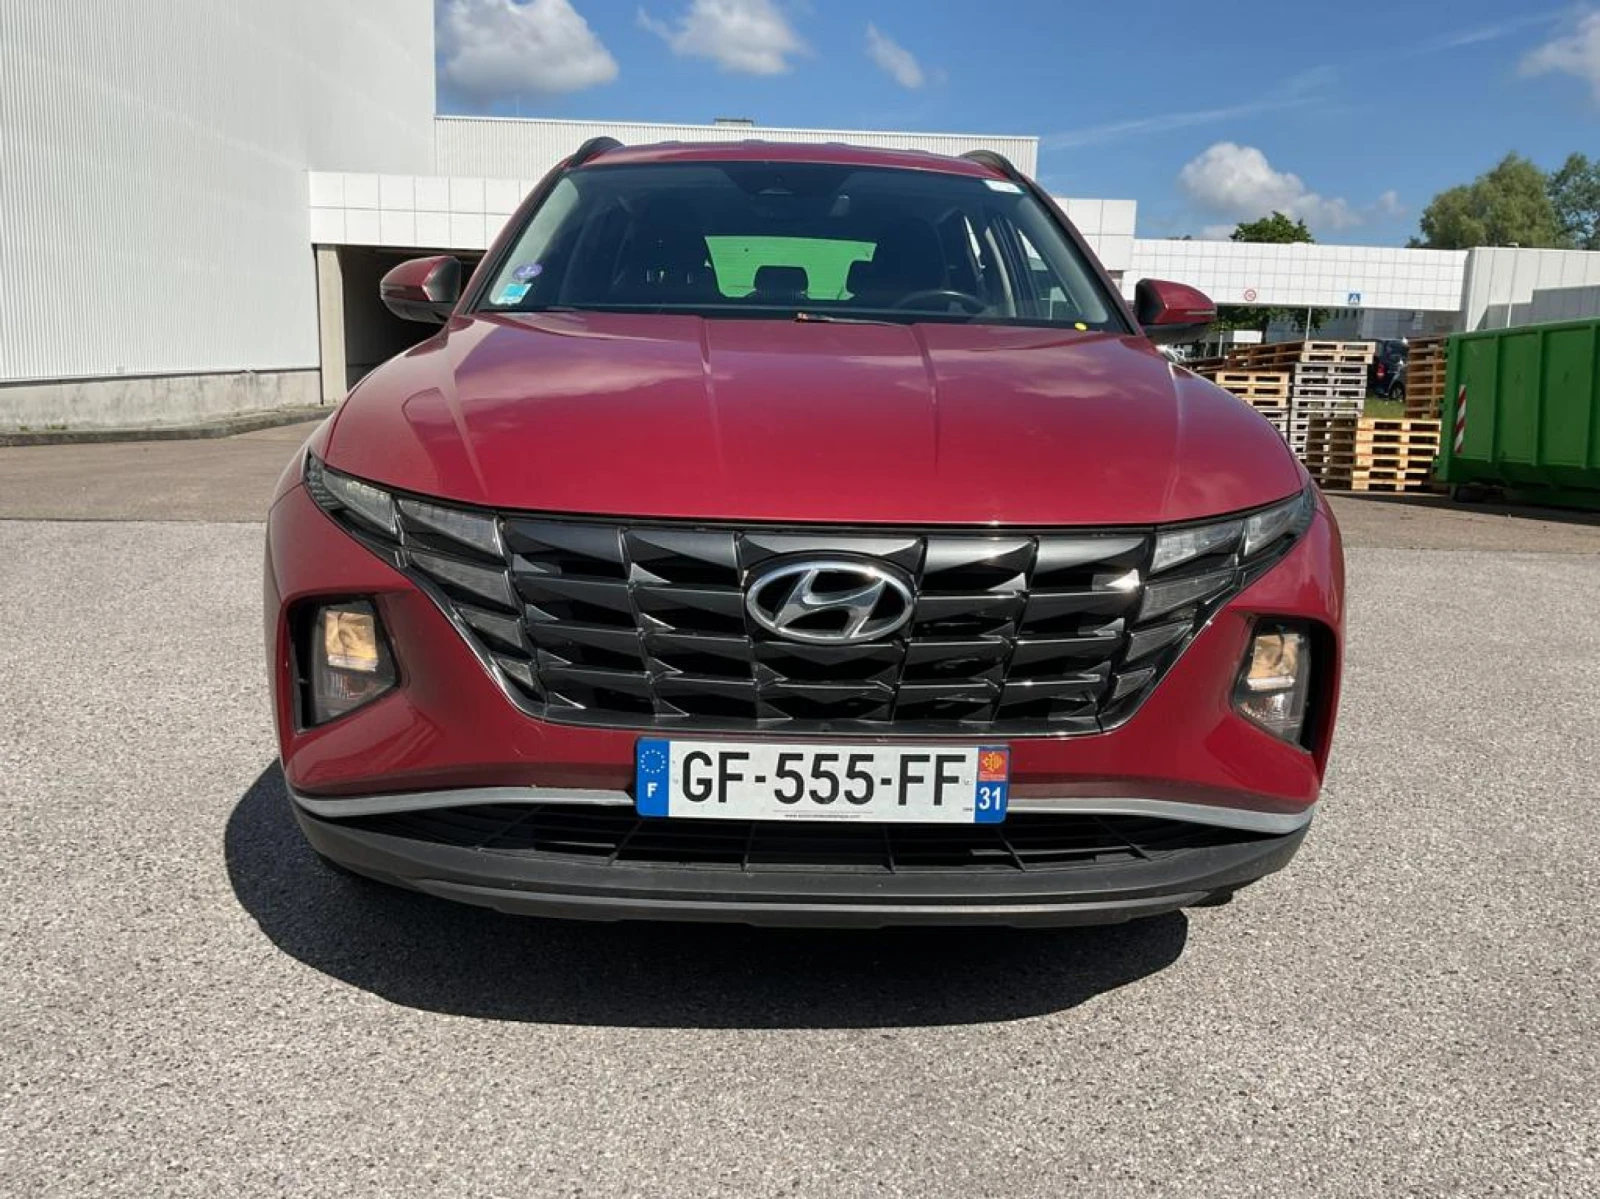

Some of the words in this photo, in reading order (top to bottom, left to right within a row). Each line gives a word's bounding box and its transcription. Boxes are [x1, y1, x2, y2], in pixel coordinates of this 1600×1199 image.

[647, 782, 658, 798] F
[682, 750, 967, 806] GF-555-FF
[979, 786, 1001, 810] 31
